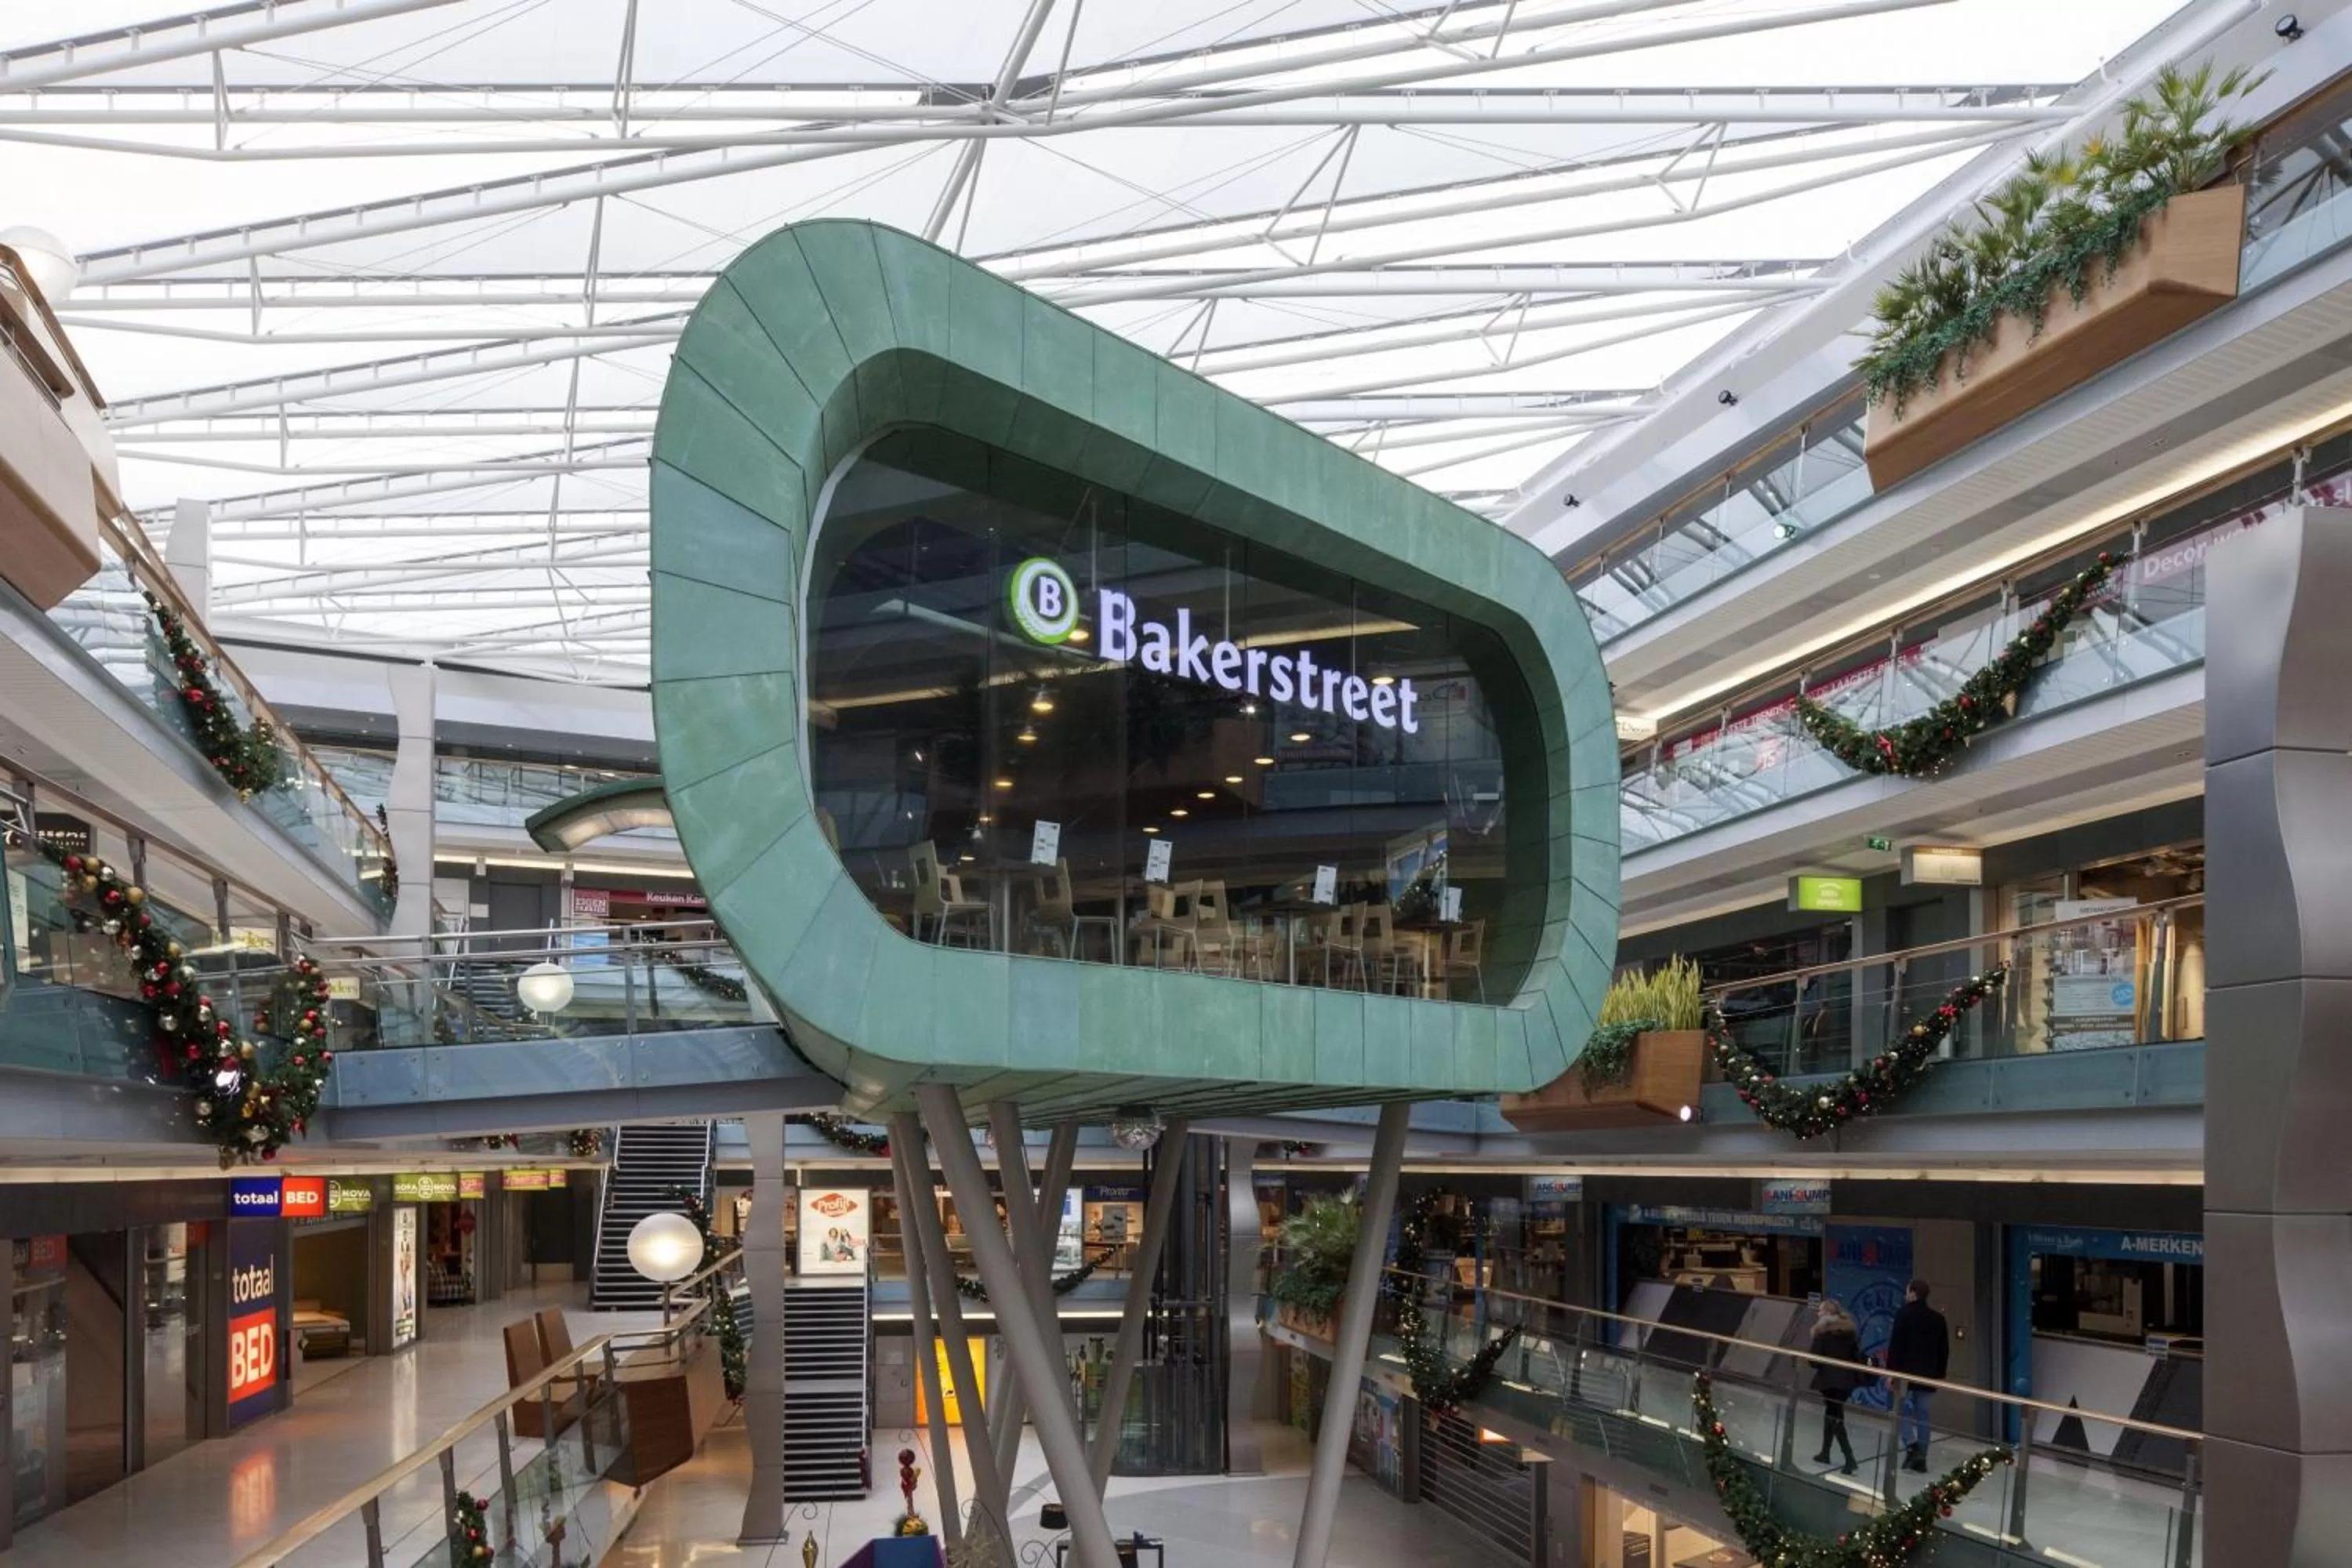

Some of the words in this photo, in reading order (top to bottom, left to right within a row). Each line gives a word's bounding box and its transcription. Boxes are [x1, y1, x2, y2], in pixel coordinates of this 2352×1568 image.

[1039, 576, 1062, 618] B
[1100, 588, 1418, 734] Bakerstreet
[233, 1190, 278, 1205] totaal
[285, 1191, 319, 1204] BED
[232, 1254, 274, 1304] totaal
[231, 1323, 274, 1390] BED
